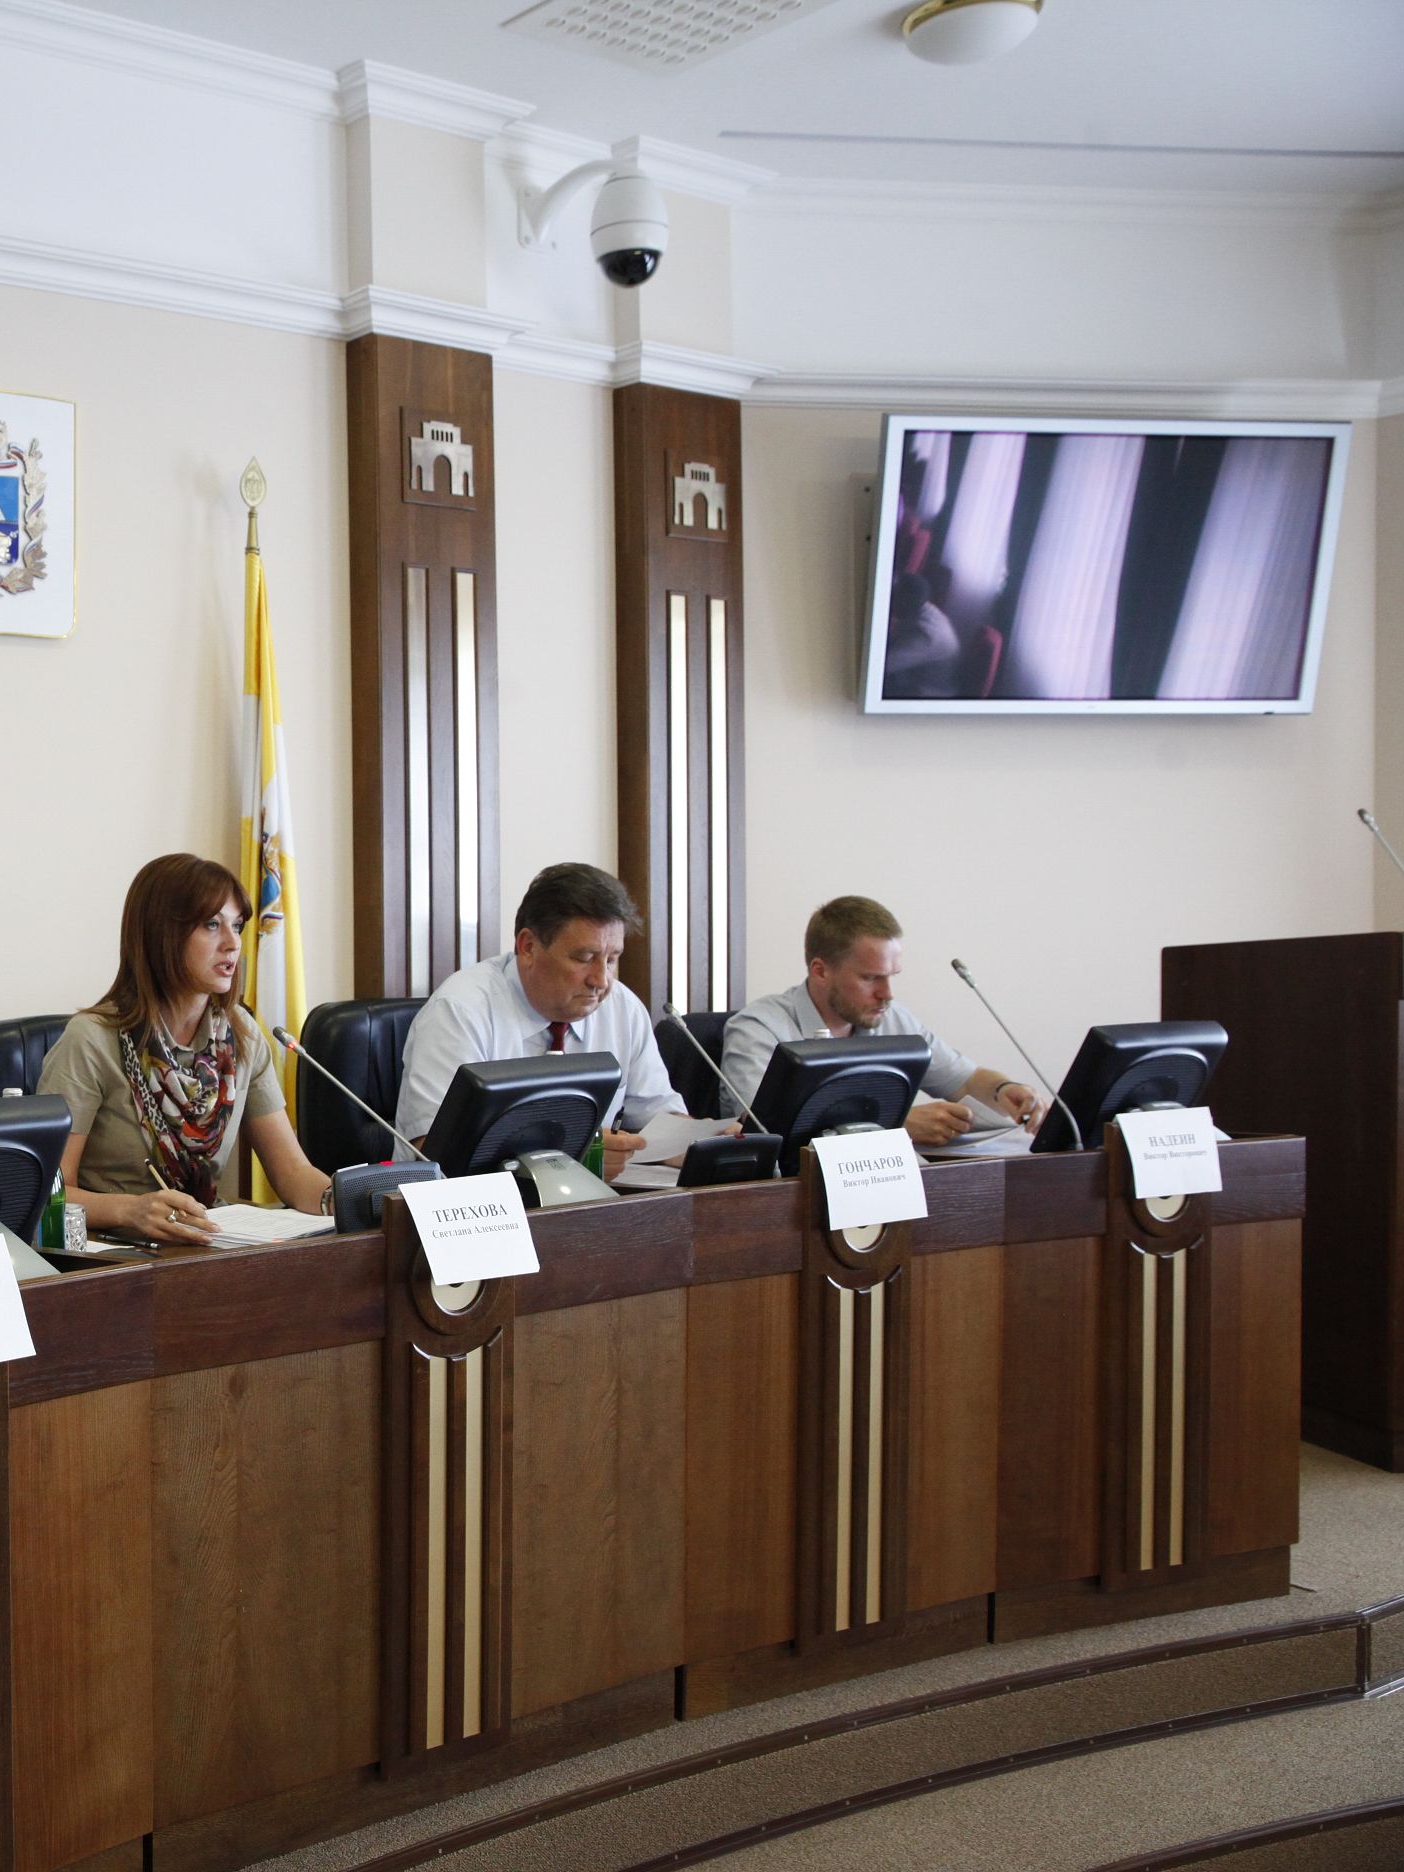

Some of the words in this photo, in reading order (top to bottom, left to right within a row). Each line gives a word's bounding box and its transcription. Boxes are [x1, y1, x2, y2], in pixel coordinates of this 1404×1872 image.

[838, 1156, 904, 1174] ГОНЧАРОВ
[432, 1203, 508, 1223] ТЕРЕХОВА
[432, 1227, 472, 1239] Светлана
[474, 1222, 519, 1234] Алексеевна
